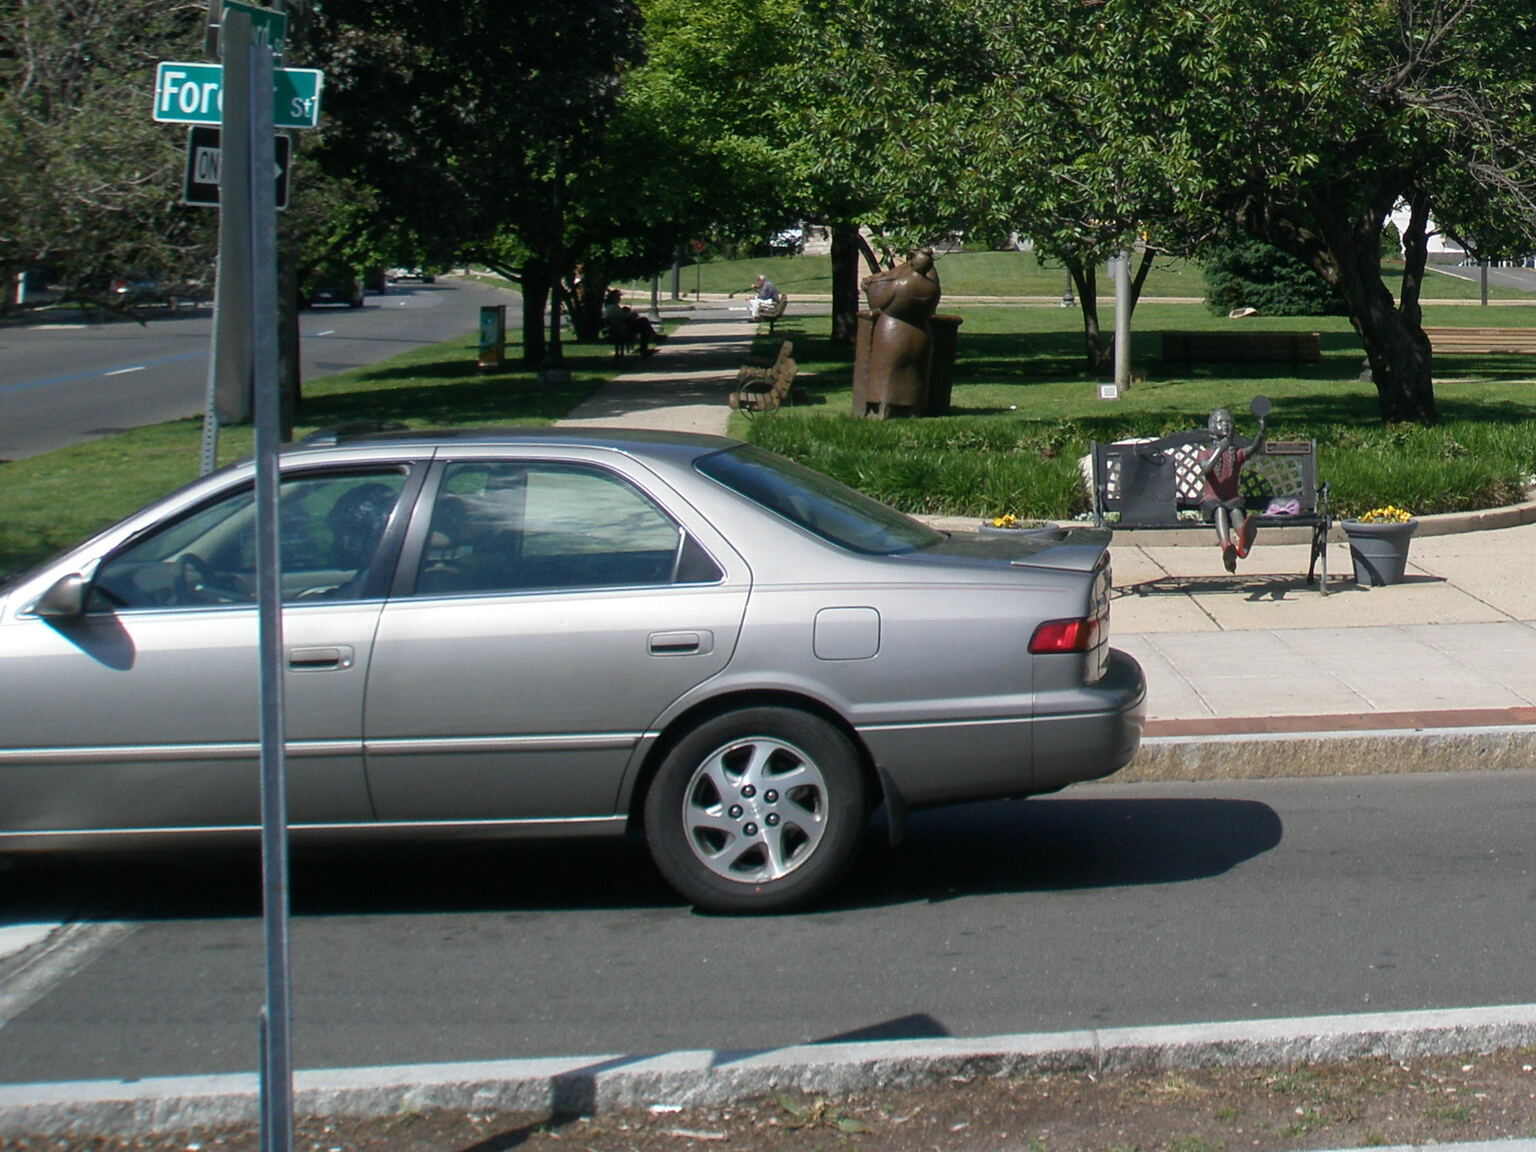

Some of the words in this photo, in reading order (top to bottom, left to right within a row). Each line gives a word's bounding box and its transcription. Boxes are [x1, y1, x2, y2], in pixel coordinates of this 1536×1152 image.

[161, 71, 223, 114] For
[291, 97, 312, 118] St
[199, 151, 220, 180] ON
